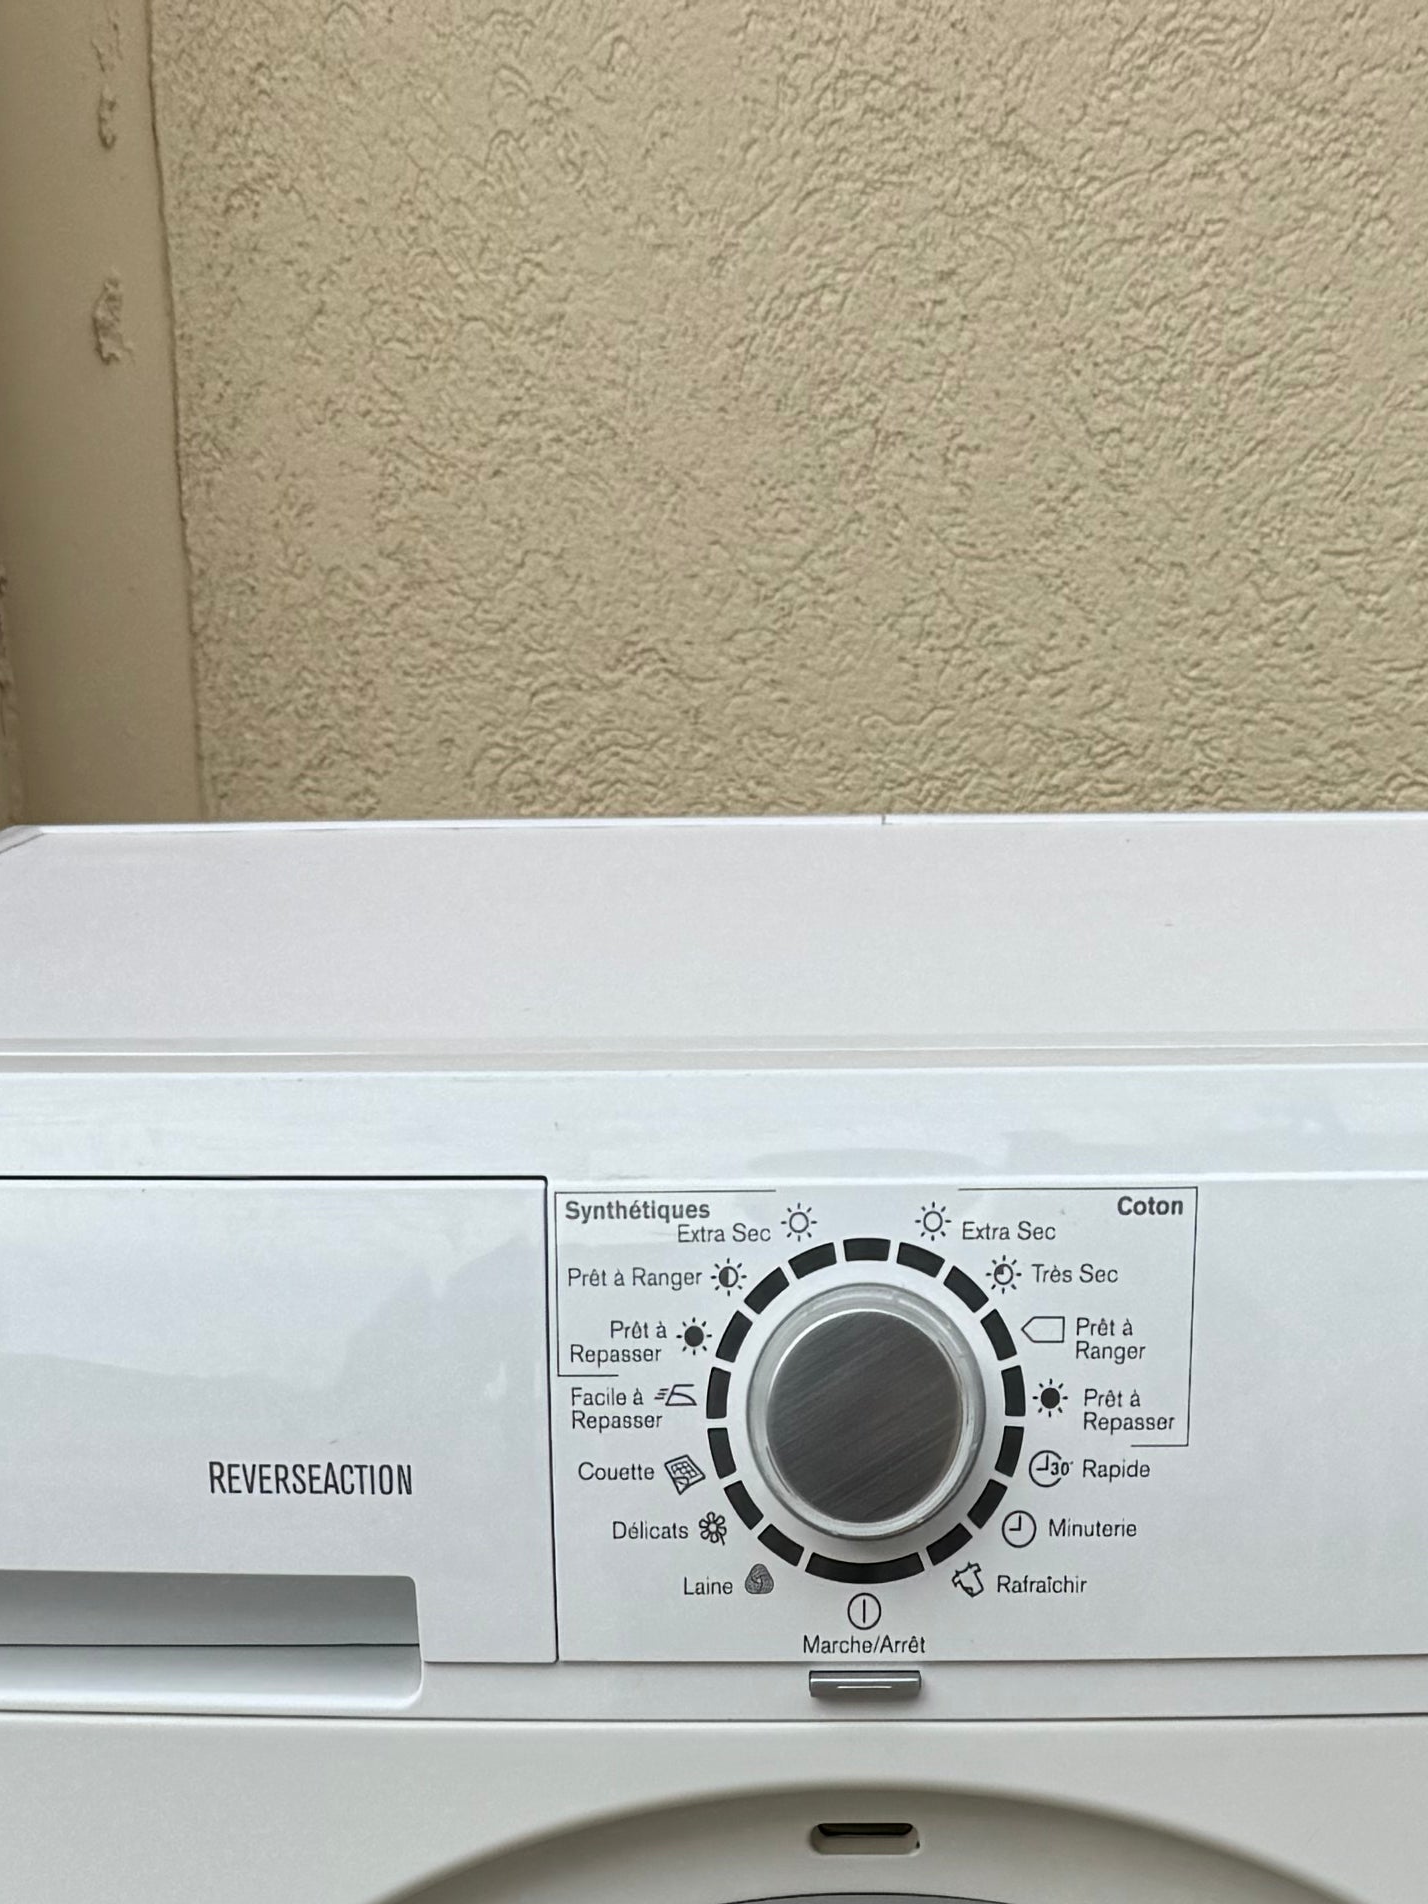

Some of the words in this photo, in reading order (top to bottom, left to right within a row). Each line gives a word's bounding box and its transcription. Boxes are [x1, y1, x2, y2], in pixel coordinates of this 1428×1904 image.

[565, 1200, 711, 1223] Synthétiques
[1117, 1196, 1184, 1216] Coton
[677, 1224, 726, 1243] Extra
[732, 1223, 772, 1242] Sec
[962, 1221, 1011, 1240] Extra
[1017, 1221, 1056, 1240] Sec
[568, 1267, 607, 1287] Prêt
[614, 1269, 626, 1287] à
[632, 1267, 703, 1290] Ranger
[1032, 1264, 1072, 1284] Très
[1079, 1263, 1119, 1283] Sec
[610, 1320, 650, 1339] Prêt
[656, 1320, 668, 1339] à
[1076, 1317, 1116, 1337] Prêt
[1122, 1318, 1134, 1336] à
[570, 1345, 662, 1368] Repasser
[1075, 1341, 1146, 1365] Ranger
[572, 1387, 627, 1407] Facile
[633, 1387, 644, 1406] à
[1084, 1388, 1123, 1408] Prêt
[1130, 1389, 1141, 1408] à
[572, 1410, 663, 1433] Repasser
[1083, 1412, 1176, 1434] Repasser
[208, 1459, 413, 1496] REVERSEACTION
[578, 1461, 655, 1481] Couette
[1082, 1459, 1151, 1482] Rapide
[612, 1520, 689, 1540] Délicats
[1049, 1519, 1137, 1538] Minuterie
[684, 1577, 733, 1596] Laine
[997, 1575, 1088, 1593] Rafraîchir
[803, 1635, 926, 1655] Marche/Arrêt
